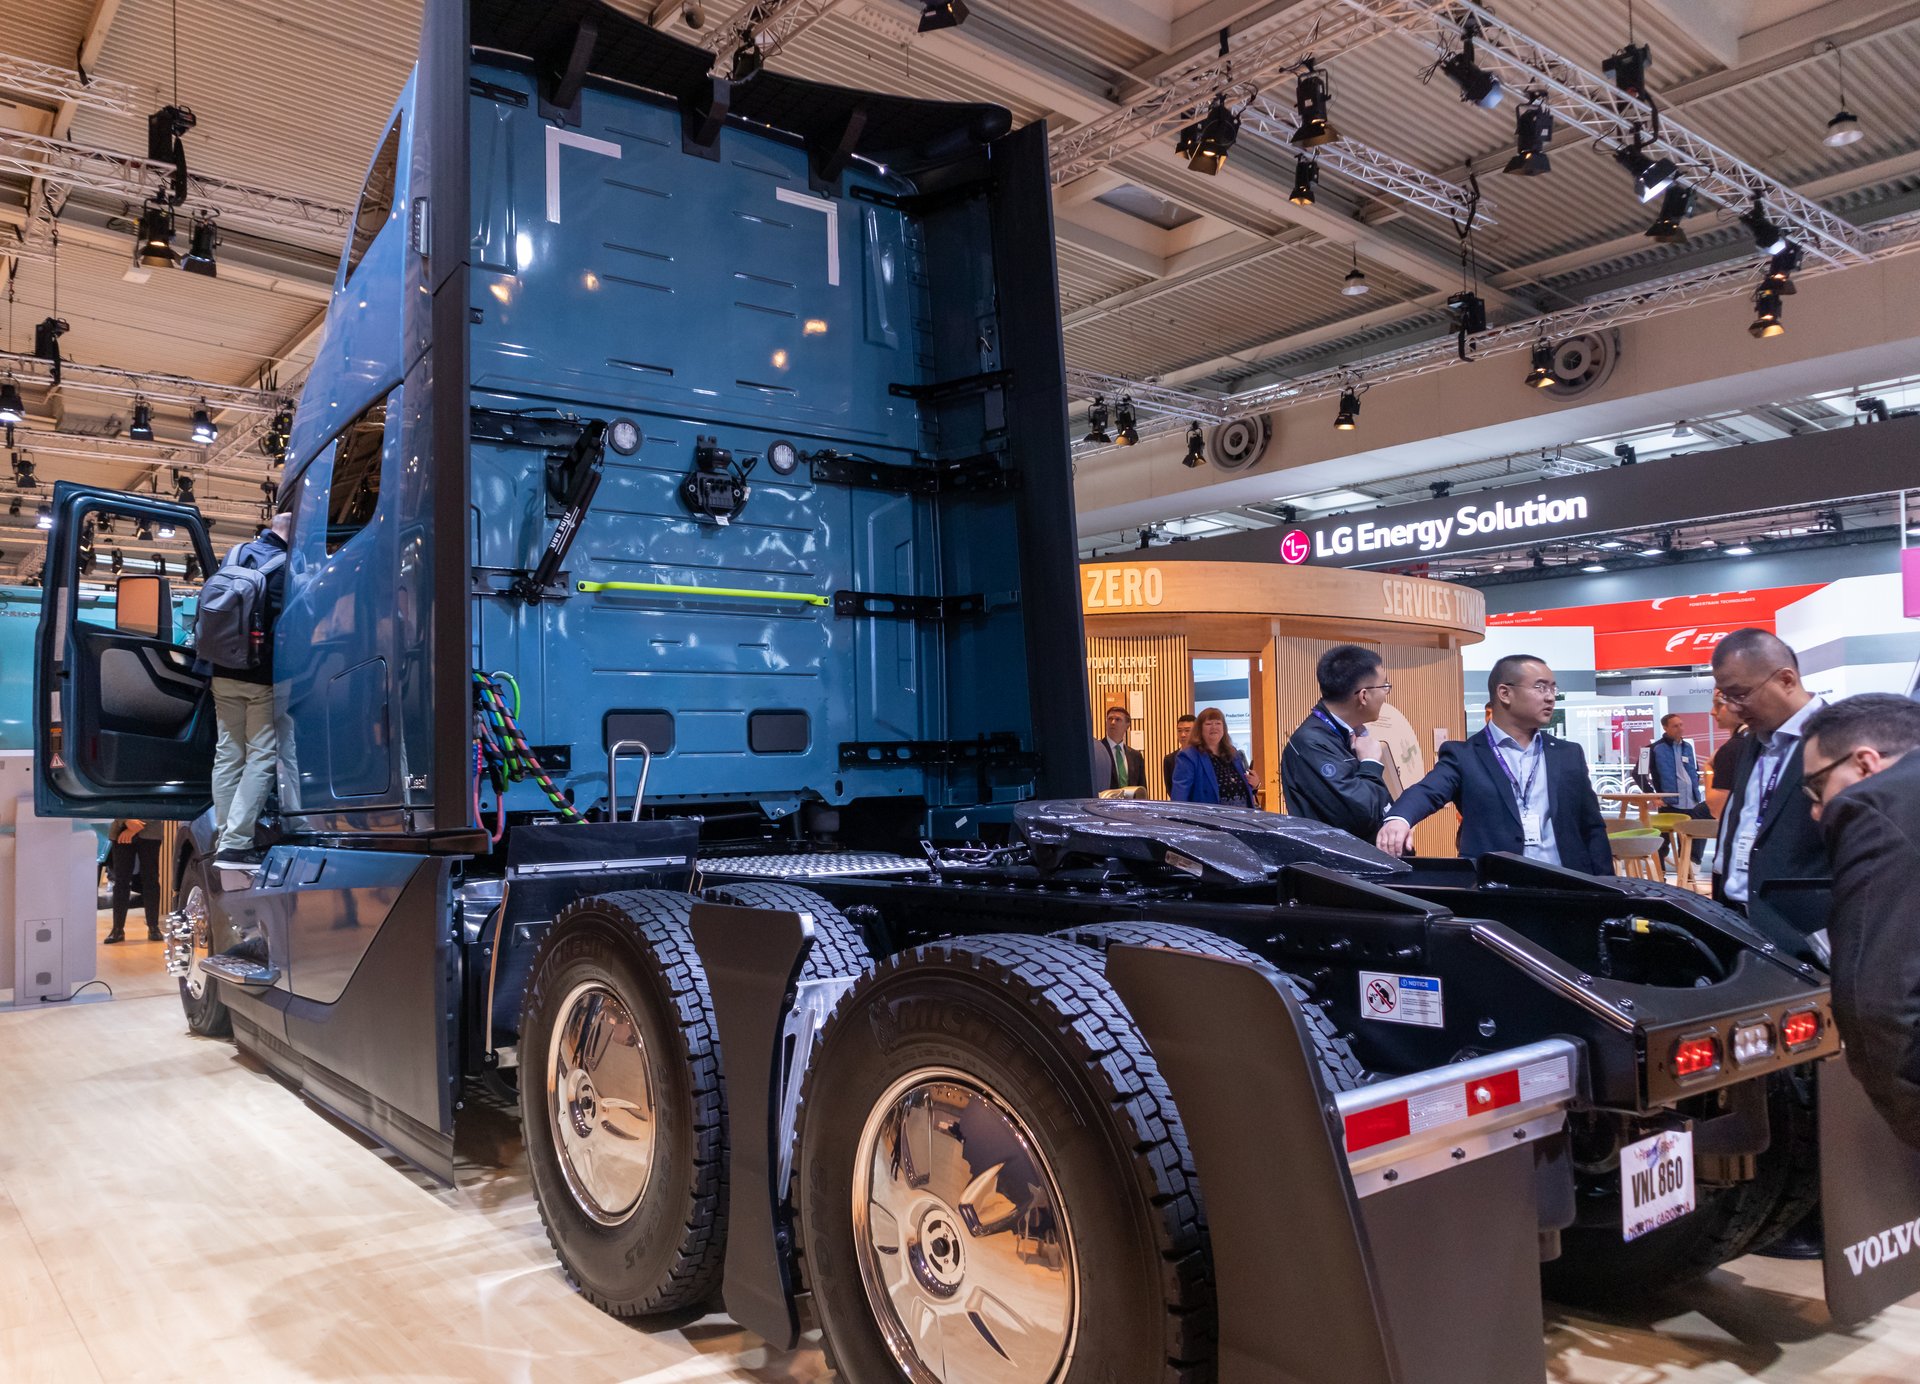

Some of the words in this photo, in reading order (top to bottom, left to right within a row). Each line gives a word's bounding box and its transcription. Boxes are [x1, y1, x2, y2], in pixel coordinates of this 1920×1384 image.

[1315, 525, 1353, 558] LG
[1357, 516, 1453, 551] Energy
[1456, 493, 1588, 536] Solution
[1086, 567, 1164, 608] ZERO
[1382, 579, 1452, 621] SERVICES
[1693, 631, 1732, 645] FP
[1086, 656, 1115, 669] VOLVO
[1119, 655, 1158, 669] SERVICE
[1096, 672, 1151, 685] CONTRACTS
[1408, 980, 1429, 988] NOTICE
[1631, 1166, 1656, 1208] VNL
[1658, 1155, 1683, 1198] 860
